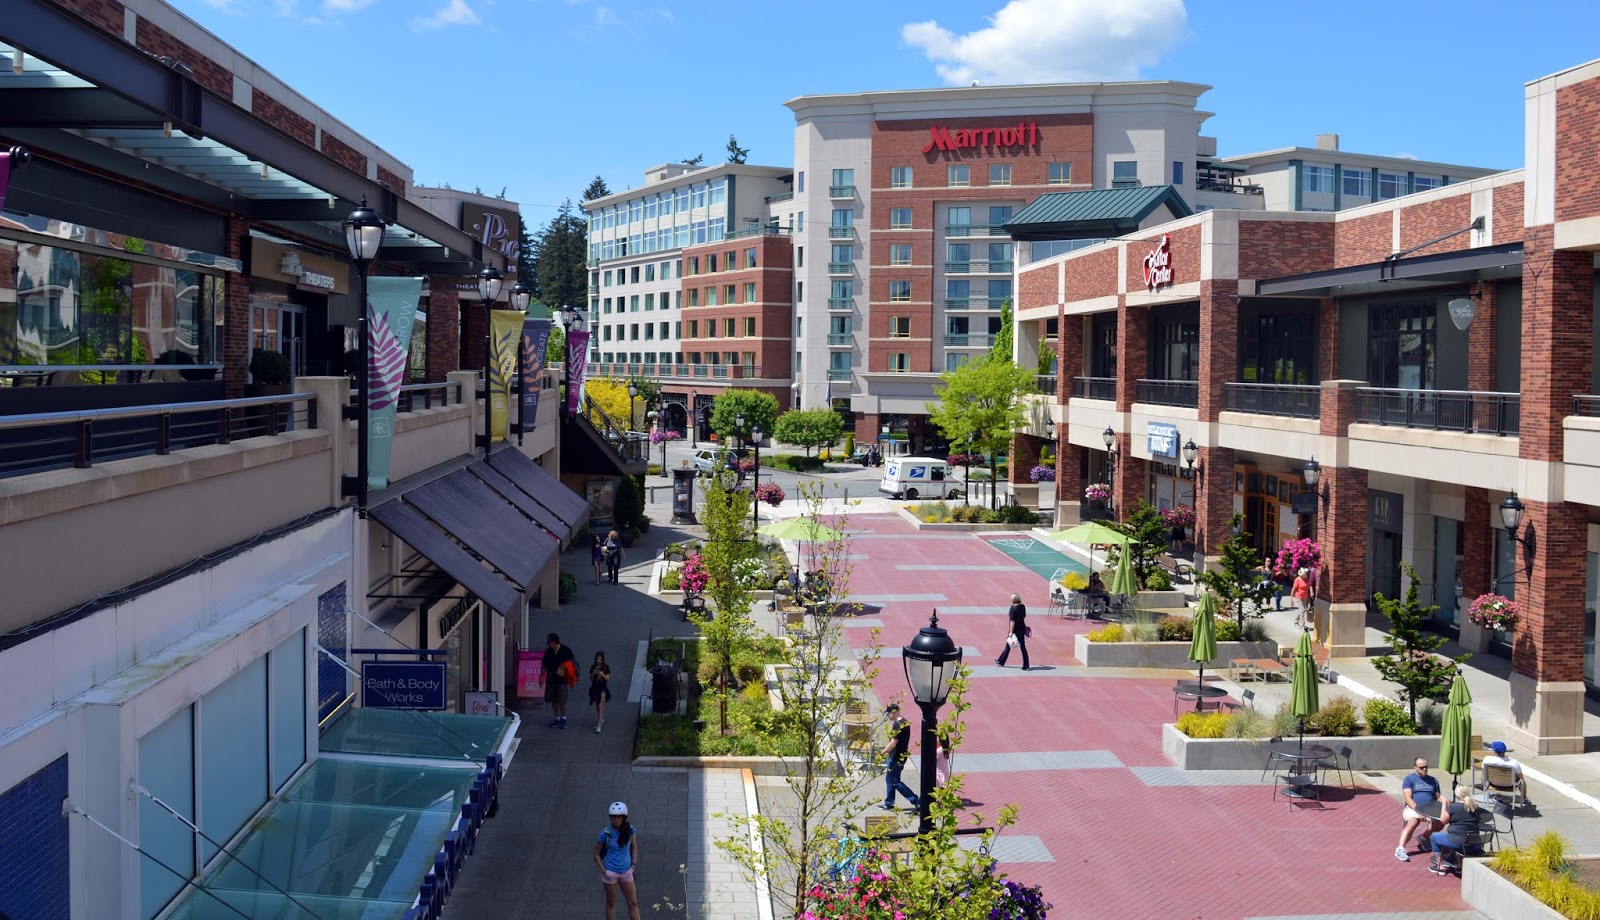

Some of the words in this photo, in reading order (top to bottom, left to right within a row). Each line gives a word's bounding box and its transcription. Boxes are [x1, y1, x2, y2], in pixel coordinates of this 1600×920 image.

[922, 122, 1037, 153] Marriott
[305, 271, 335, 290] THEATERS
[1151, 266, 1172, 286] Center
[393, 299, 413, 350] GROW
[504, 325, 519, 373] CONNECT
[536, 332, 548, 362] CREATE
[577, 339, 587, 364] GATHER
[367, 678, 396, 689] Bath
[397, 678, 407, 689] &
[408, 678, 440, 691] Body
[384, 692, 424, 702] Works
